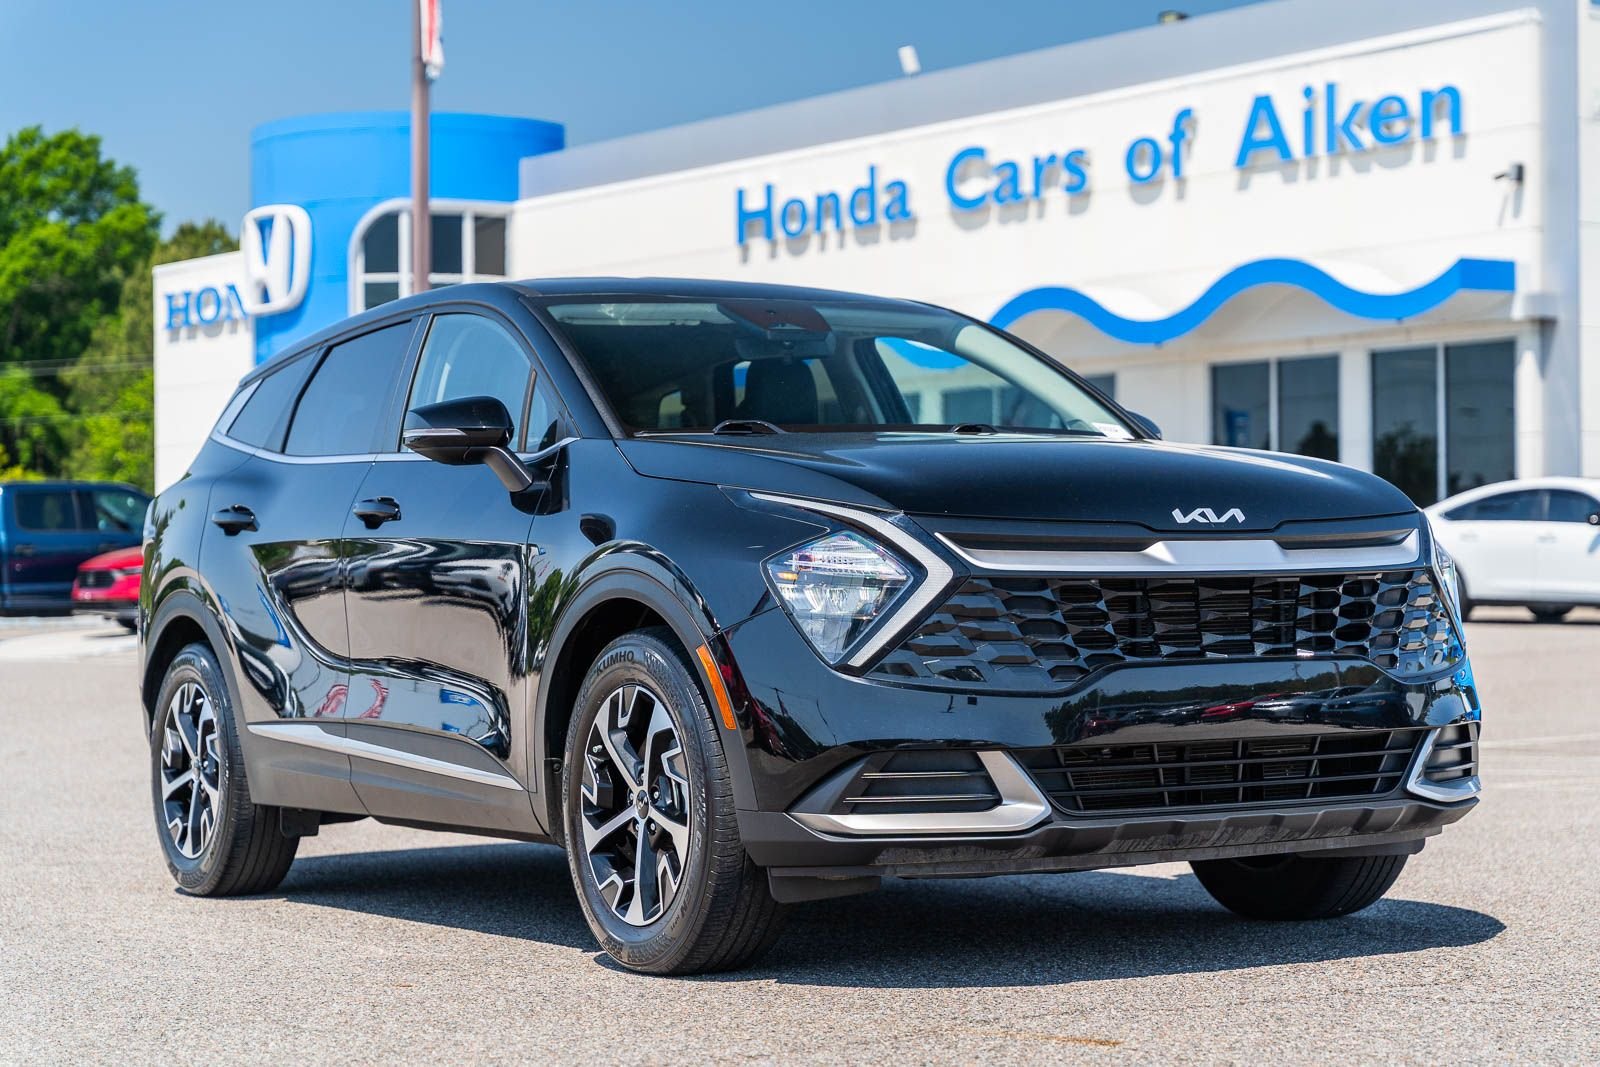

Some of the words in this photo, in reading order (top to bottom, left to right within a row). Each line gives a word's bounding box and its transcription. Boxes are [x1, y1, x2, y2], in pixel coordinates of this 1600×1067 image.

[737, 165, 911, 245] Honda
[945, 146, 1087, 209] Cars
[1126, 108, 1192, 182] of
[1235, 81, 1463, 168] Aiken
[596, 650, 635, 675] KUMHO
